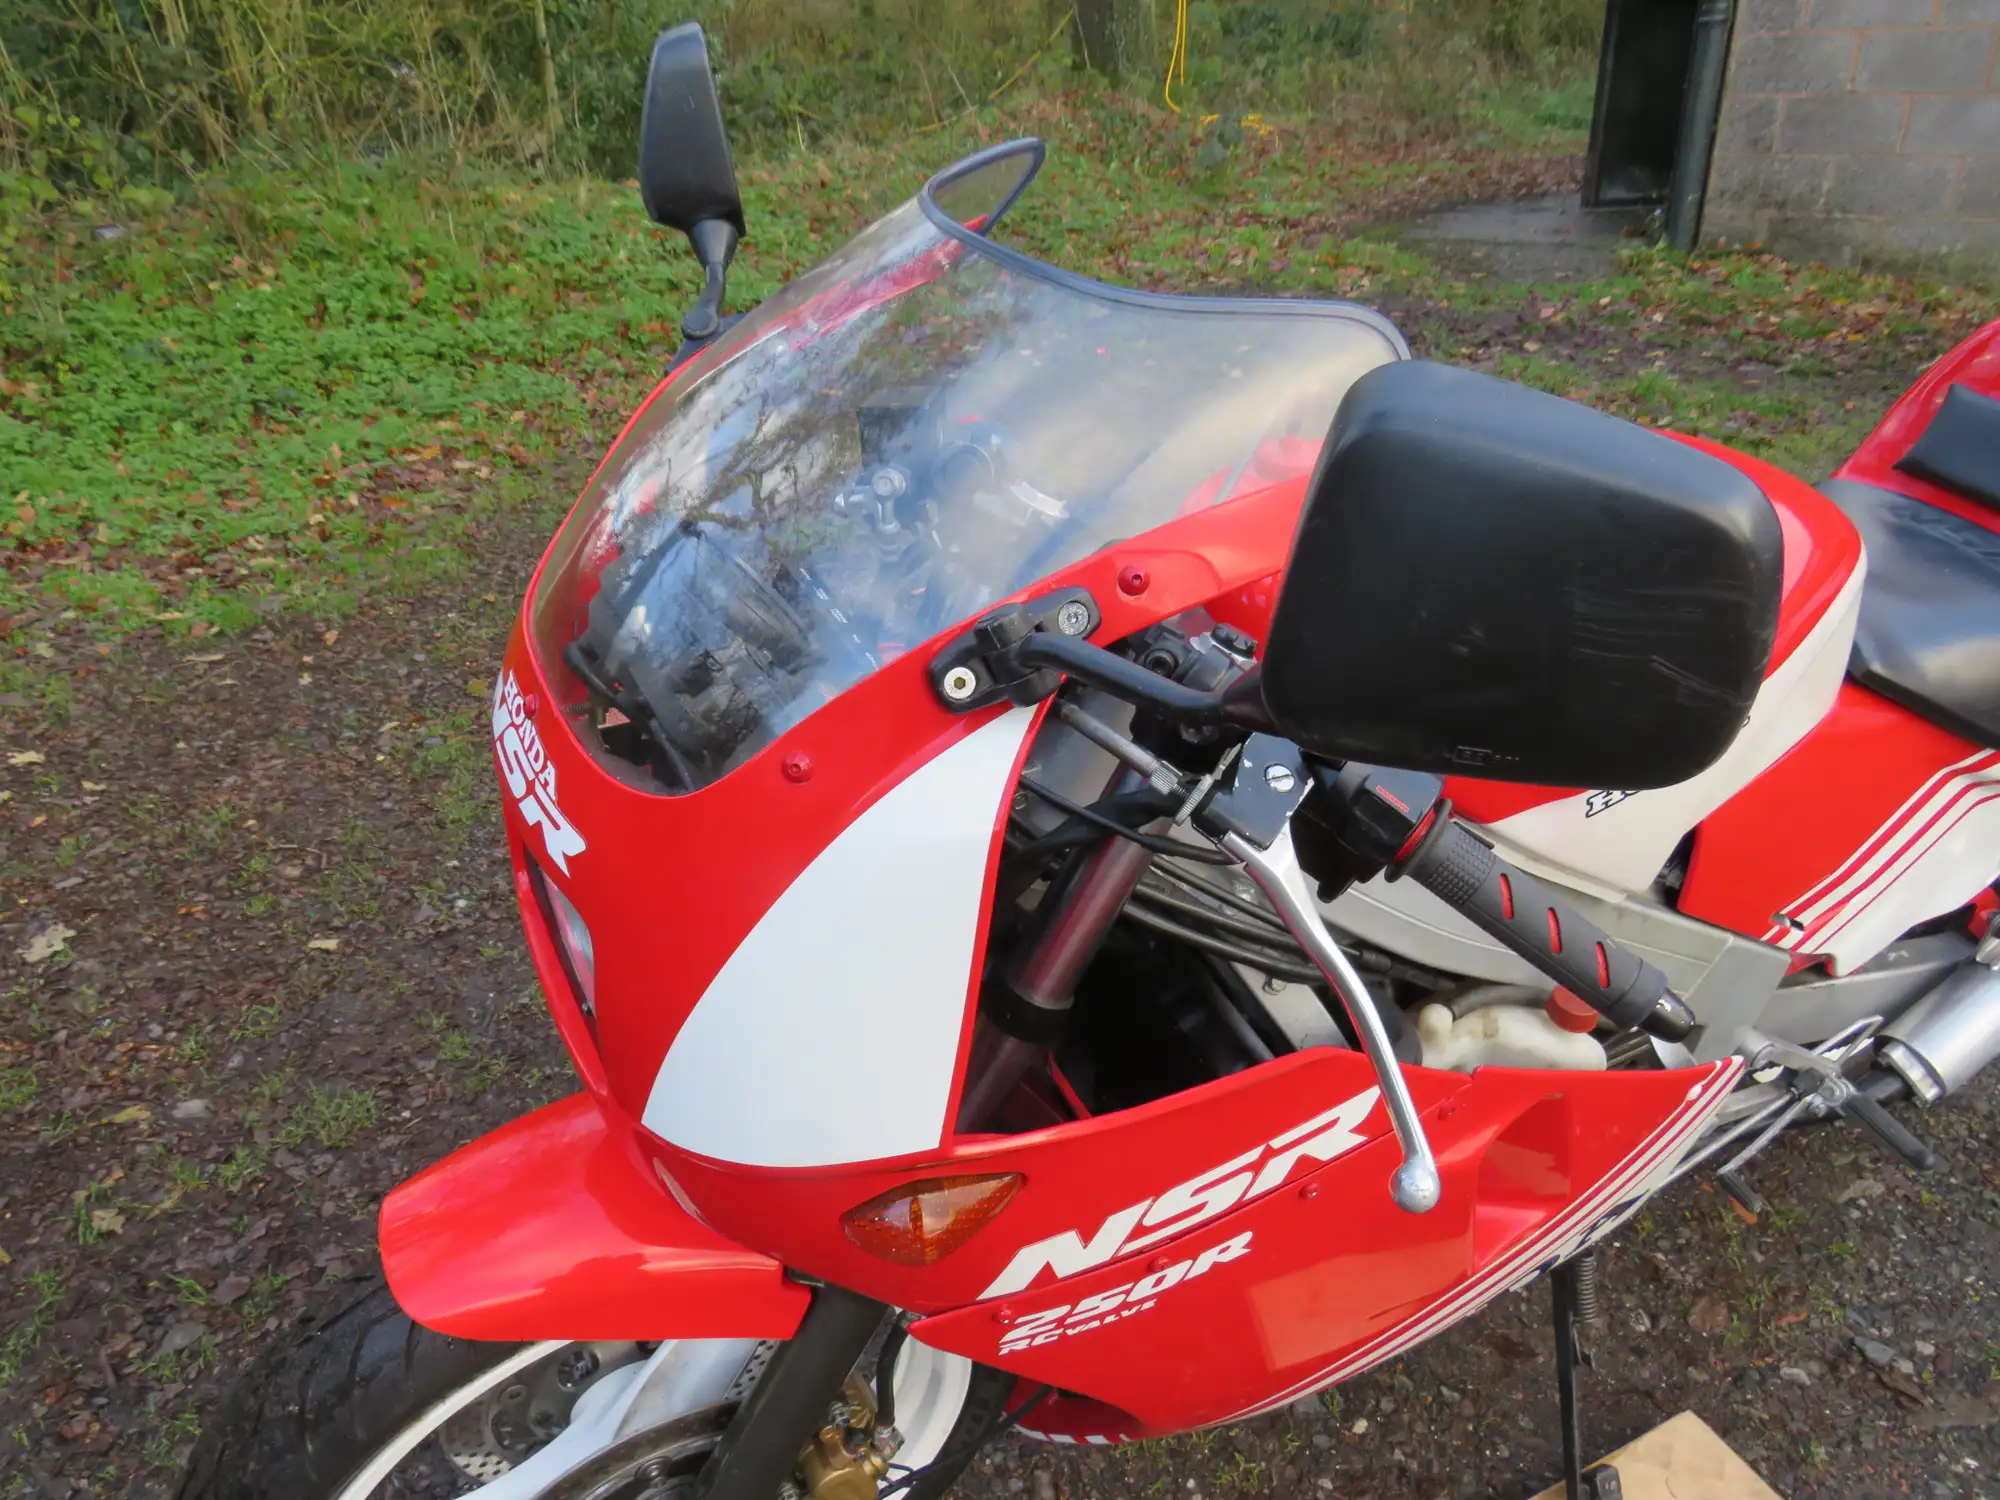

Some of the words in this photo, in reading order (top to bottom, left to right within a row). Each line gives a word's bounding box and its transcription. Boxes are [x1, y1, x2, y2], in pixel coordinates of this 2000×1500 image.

[504, 669, 556, 802] HONDA
[975, 1085, 1381, 1300] NSR
[999, 1231, 1254, 1344] 250R
